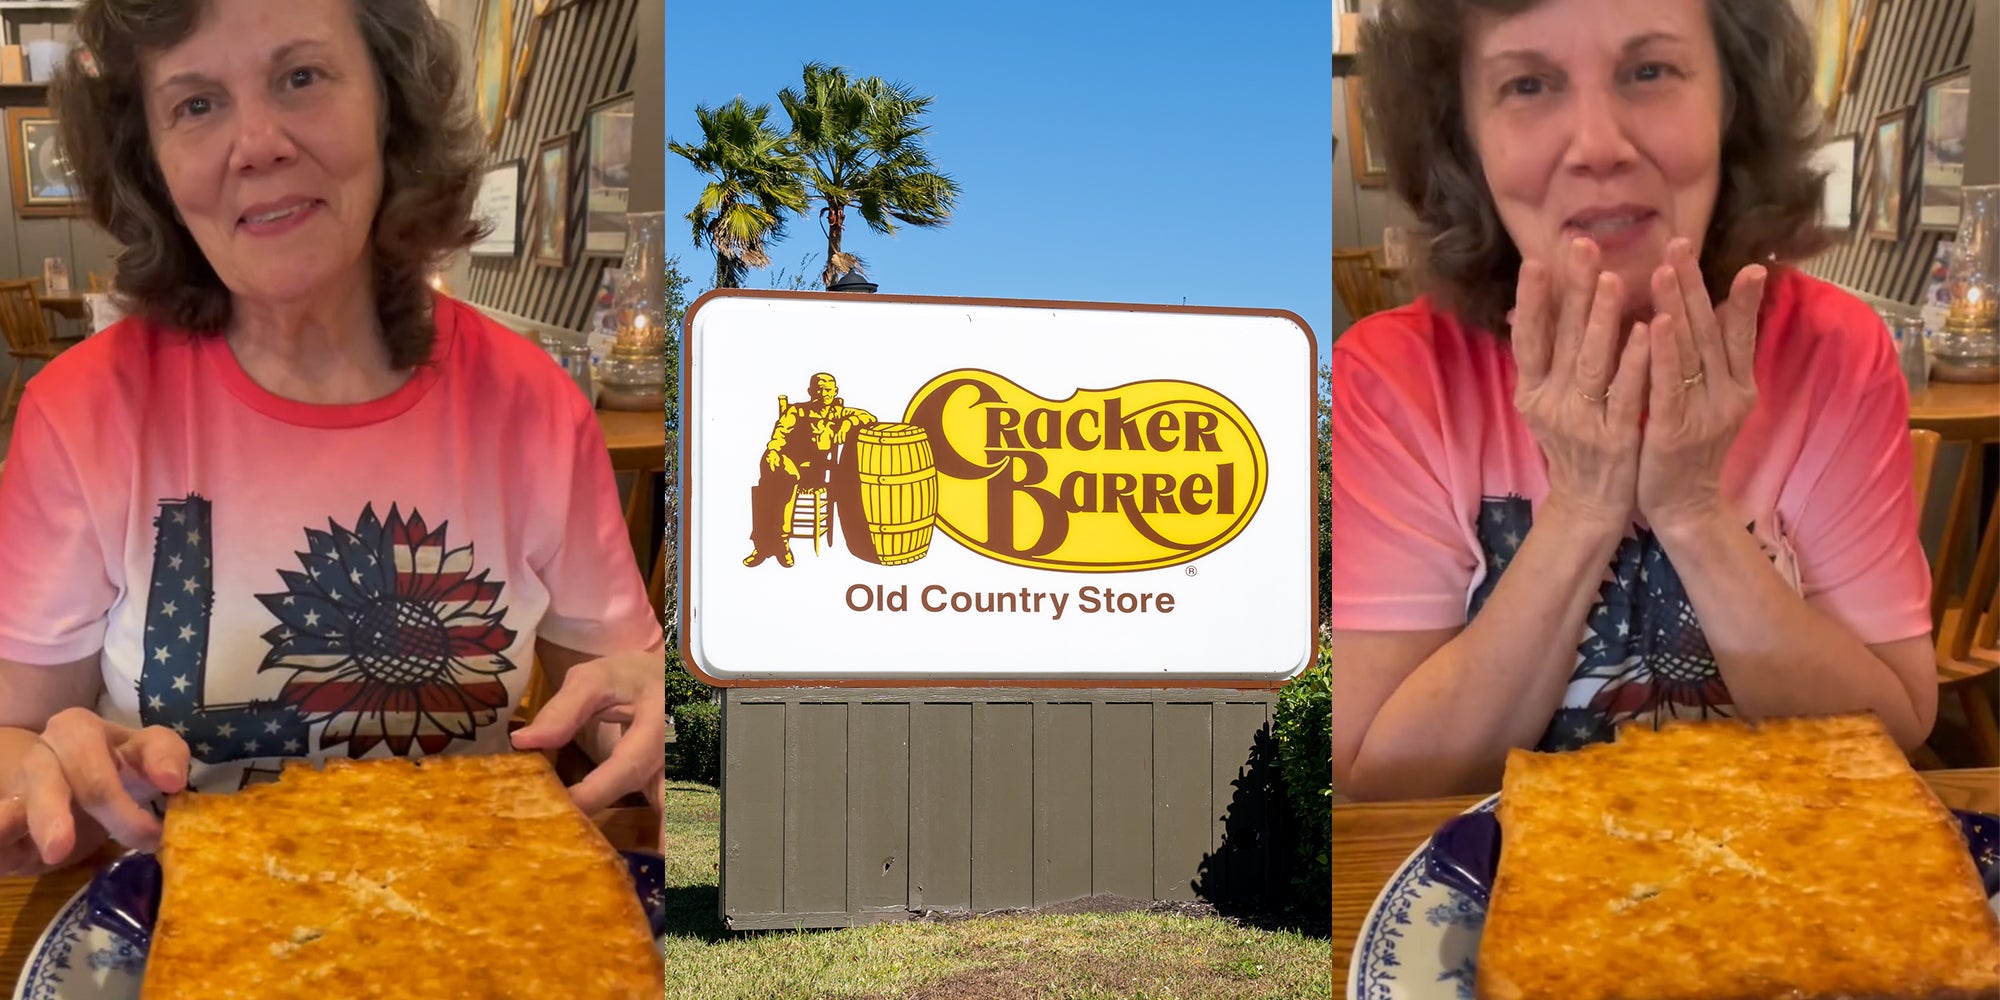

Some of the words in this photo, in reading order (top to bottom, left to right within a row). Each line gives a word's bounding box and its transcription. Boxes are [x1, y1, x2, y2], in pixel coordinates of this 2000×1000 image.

[909, 378, 1224, 481] Cracker
[983, 449, 1236, 558] Barrel
[845, 583, 908, 612] Old
[920, 585, 1070, 620] Country
[1078, 585, 1176, 614] Store
